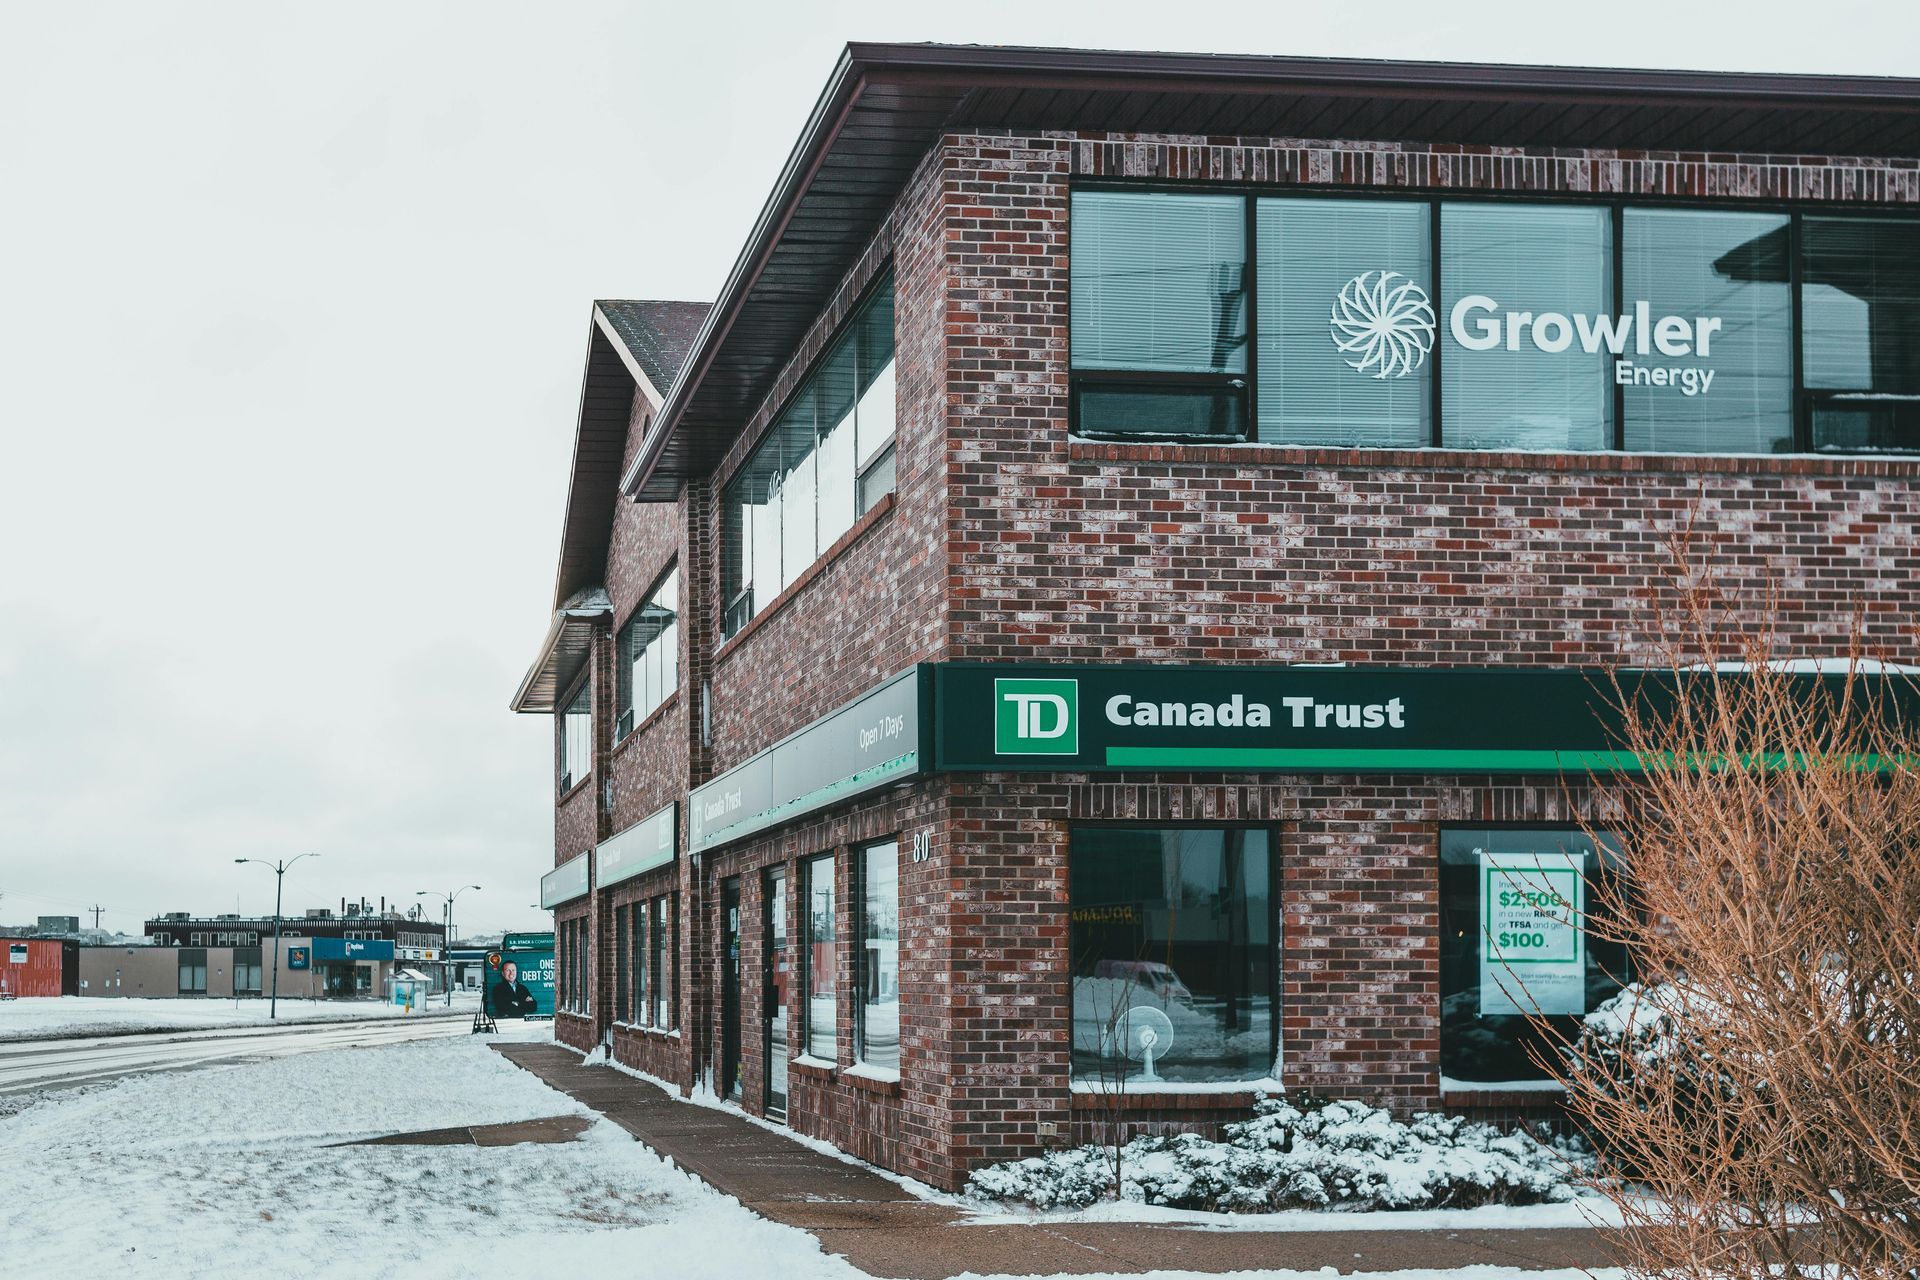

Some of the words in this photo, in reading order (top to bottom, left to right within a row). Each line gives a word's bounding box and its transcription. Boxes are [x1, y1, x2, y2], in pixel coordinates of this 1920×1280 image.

[1450, 294, 1722, 357] Growler
[1616, 361, 1716, 395] Energy
[860, 727, 878, 752] Open
[879, 719, 884, 740] 7
[886, 713, 904, 739] Days
[1003, 694, 1069, 739] TD
[1105, 694, 1271, 728] Canada
[1283, 696, 1405, 729] Trust
[913, 830, 930, 863] 80
[1499, 891, 1562, 908] $2,500
[1509, 921, 1532, 929] TFSA
[1533, 921, 1549, 929] and
[1551, 922, 1564, 931] get
[522, 971, 542, 981] DEBT
[539, 959, 555, 969] ONE
